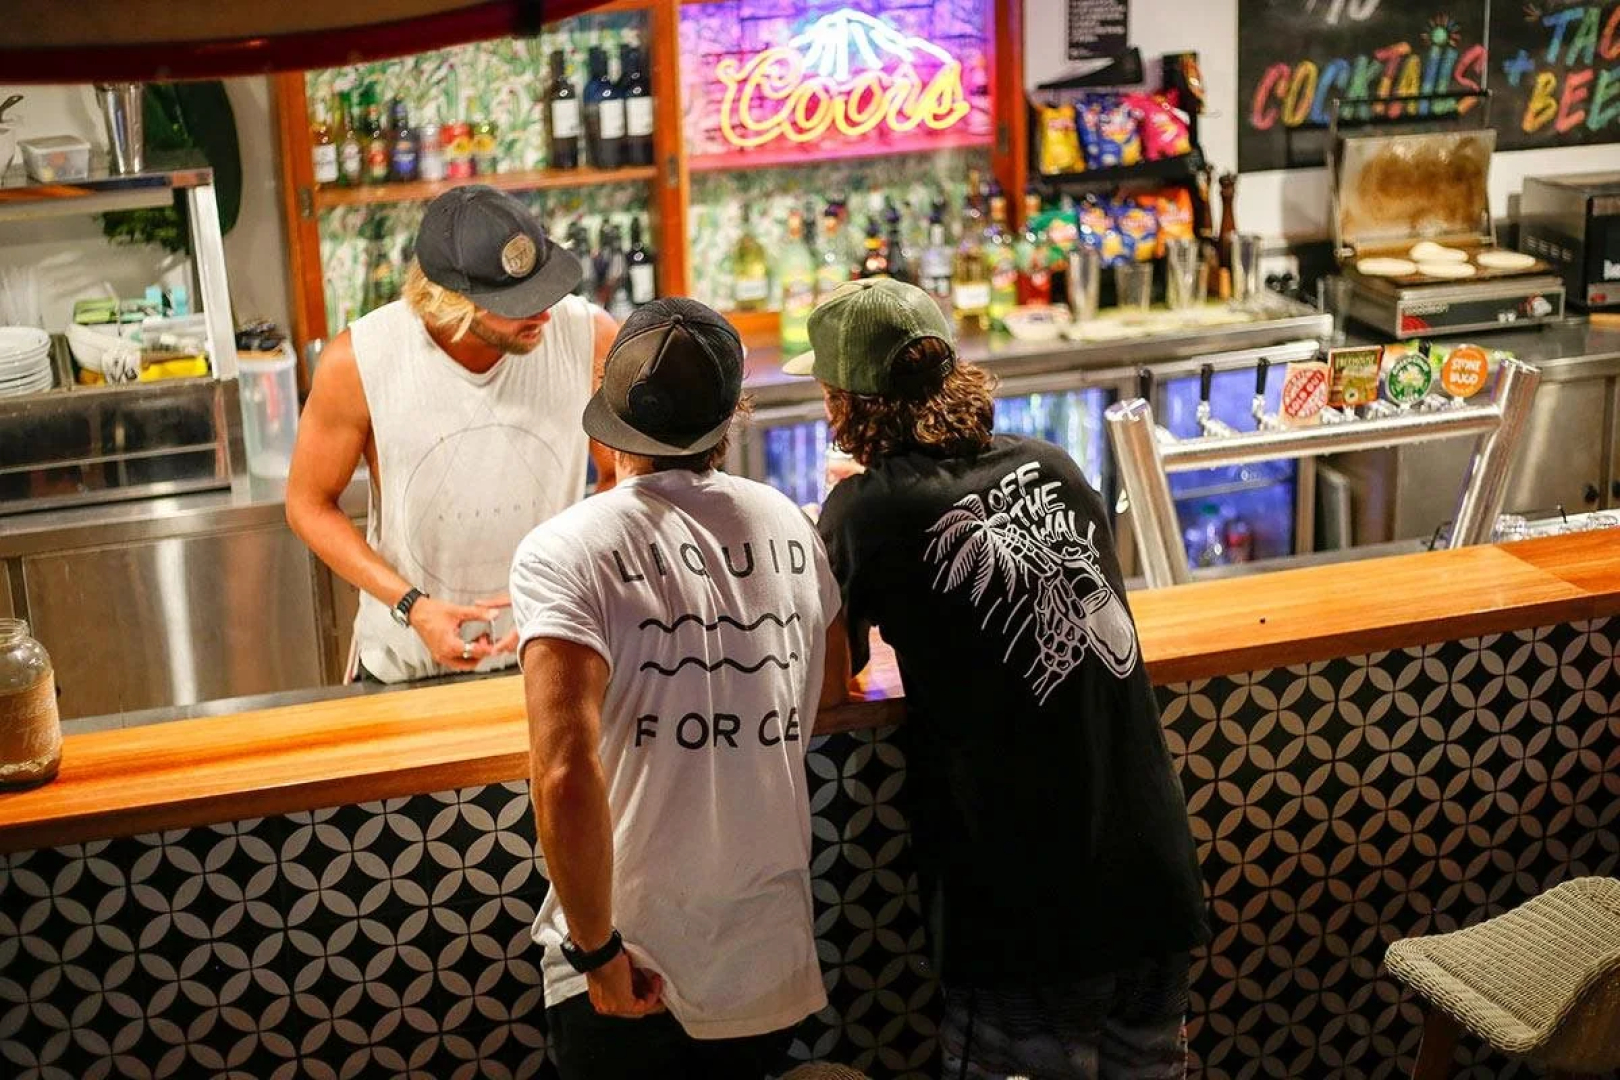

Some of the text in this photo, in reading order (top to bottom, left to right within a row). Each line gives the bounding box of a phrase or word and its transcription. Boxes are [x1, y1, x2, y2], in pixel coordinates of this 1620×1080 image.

[716, 46, 972, 147] Coors
[1251, 42, 1489, 130] COCKTAILS
[987, 461, 1041, 513] OFF
[1010, 481, 1065, 527] THE
[1030, 510, 1100, 557] WALL
[612, 539, 807, 583] LIQUID
[634, 707, 801, 750] FORCE
